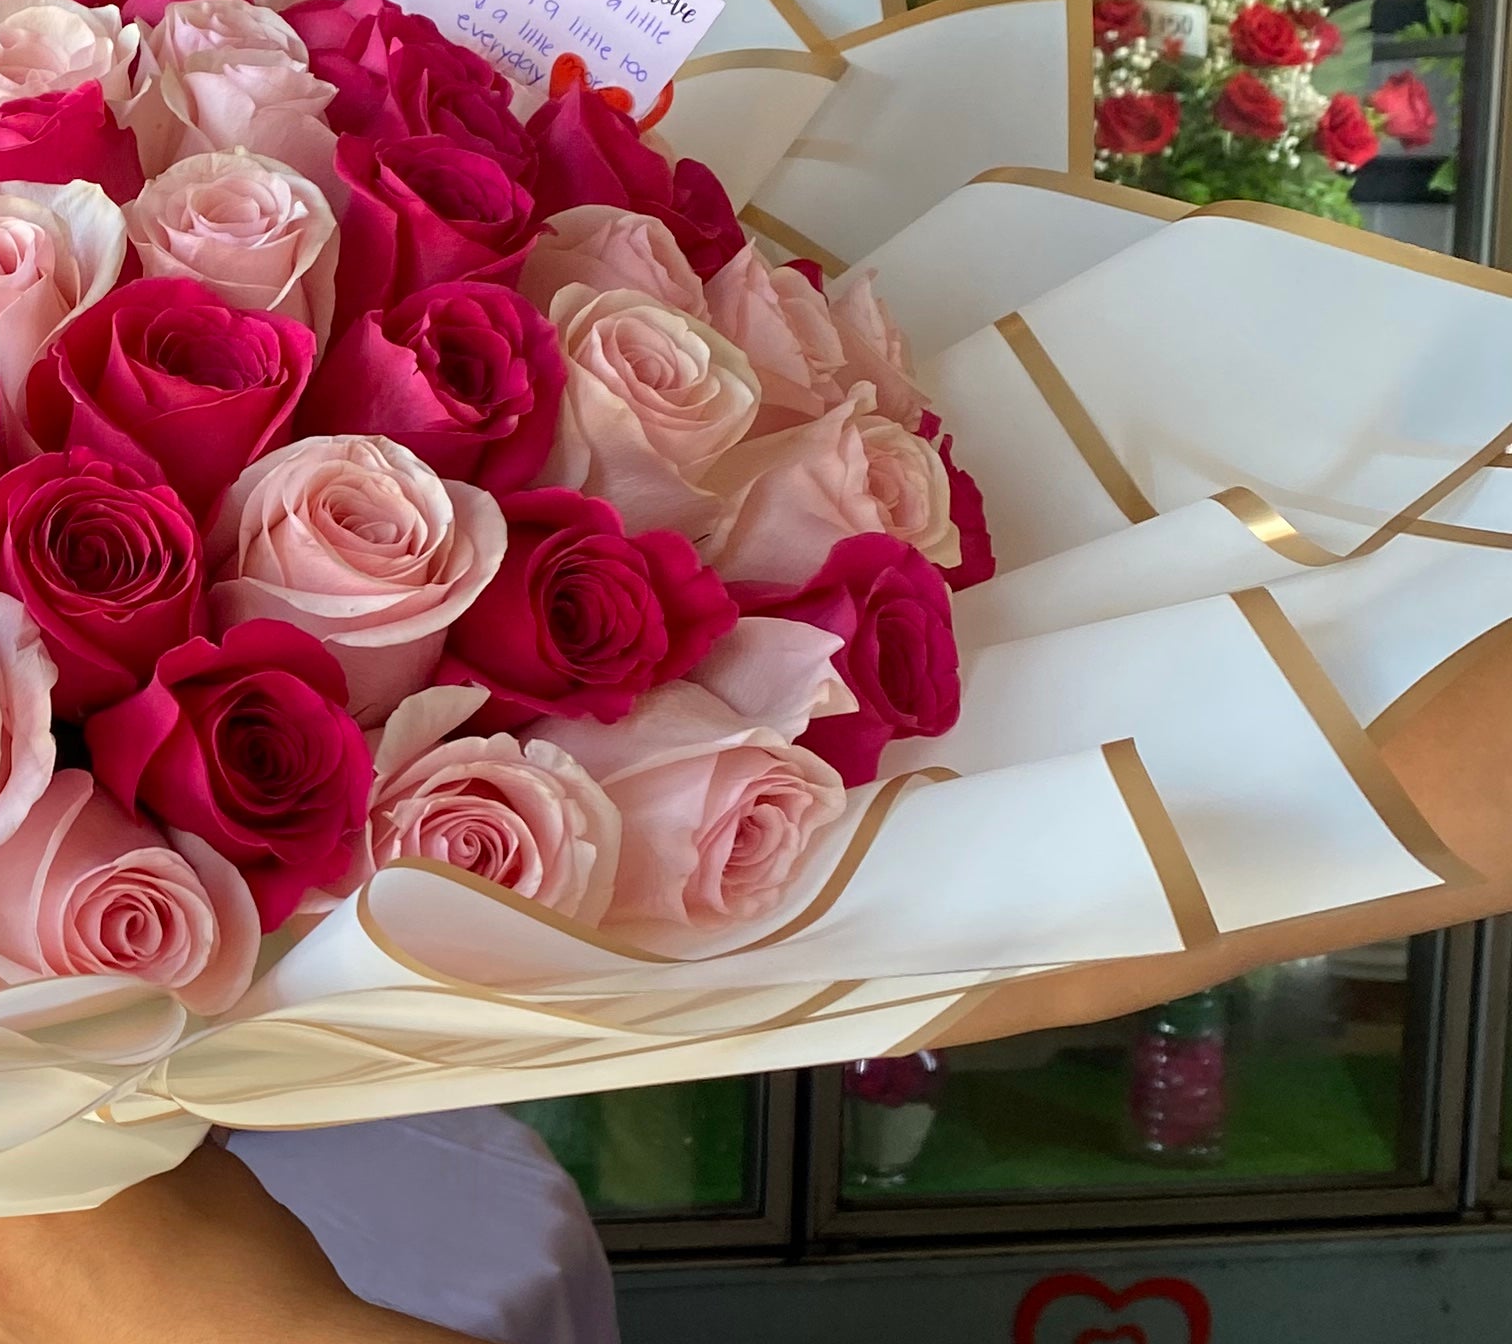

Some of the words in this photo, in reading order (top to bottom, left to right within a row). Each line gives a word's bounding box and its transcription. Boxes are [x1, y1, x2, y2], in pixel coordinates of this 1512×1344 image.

[456, 12, 546, 87] everyday
[491, 8, 509, 24] a
[517, 18, 555, 57] little
[543, 0, 560, 21] a
[568, 15, 612, 60] little
[619, 53, 648, 83] too
[625, 5, 671, 45] little
